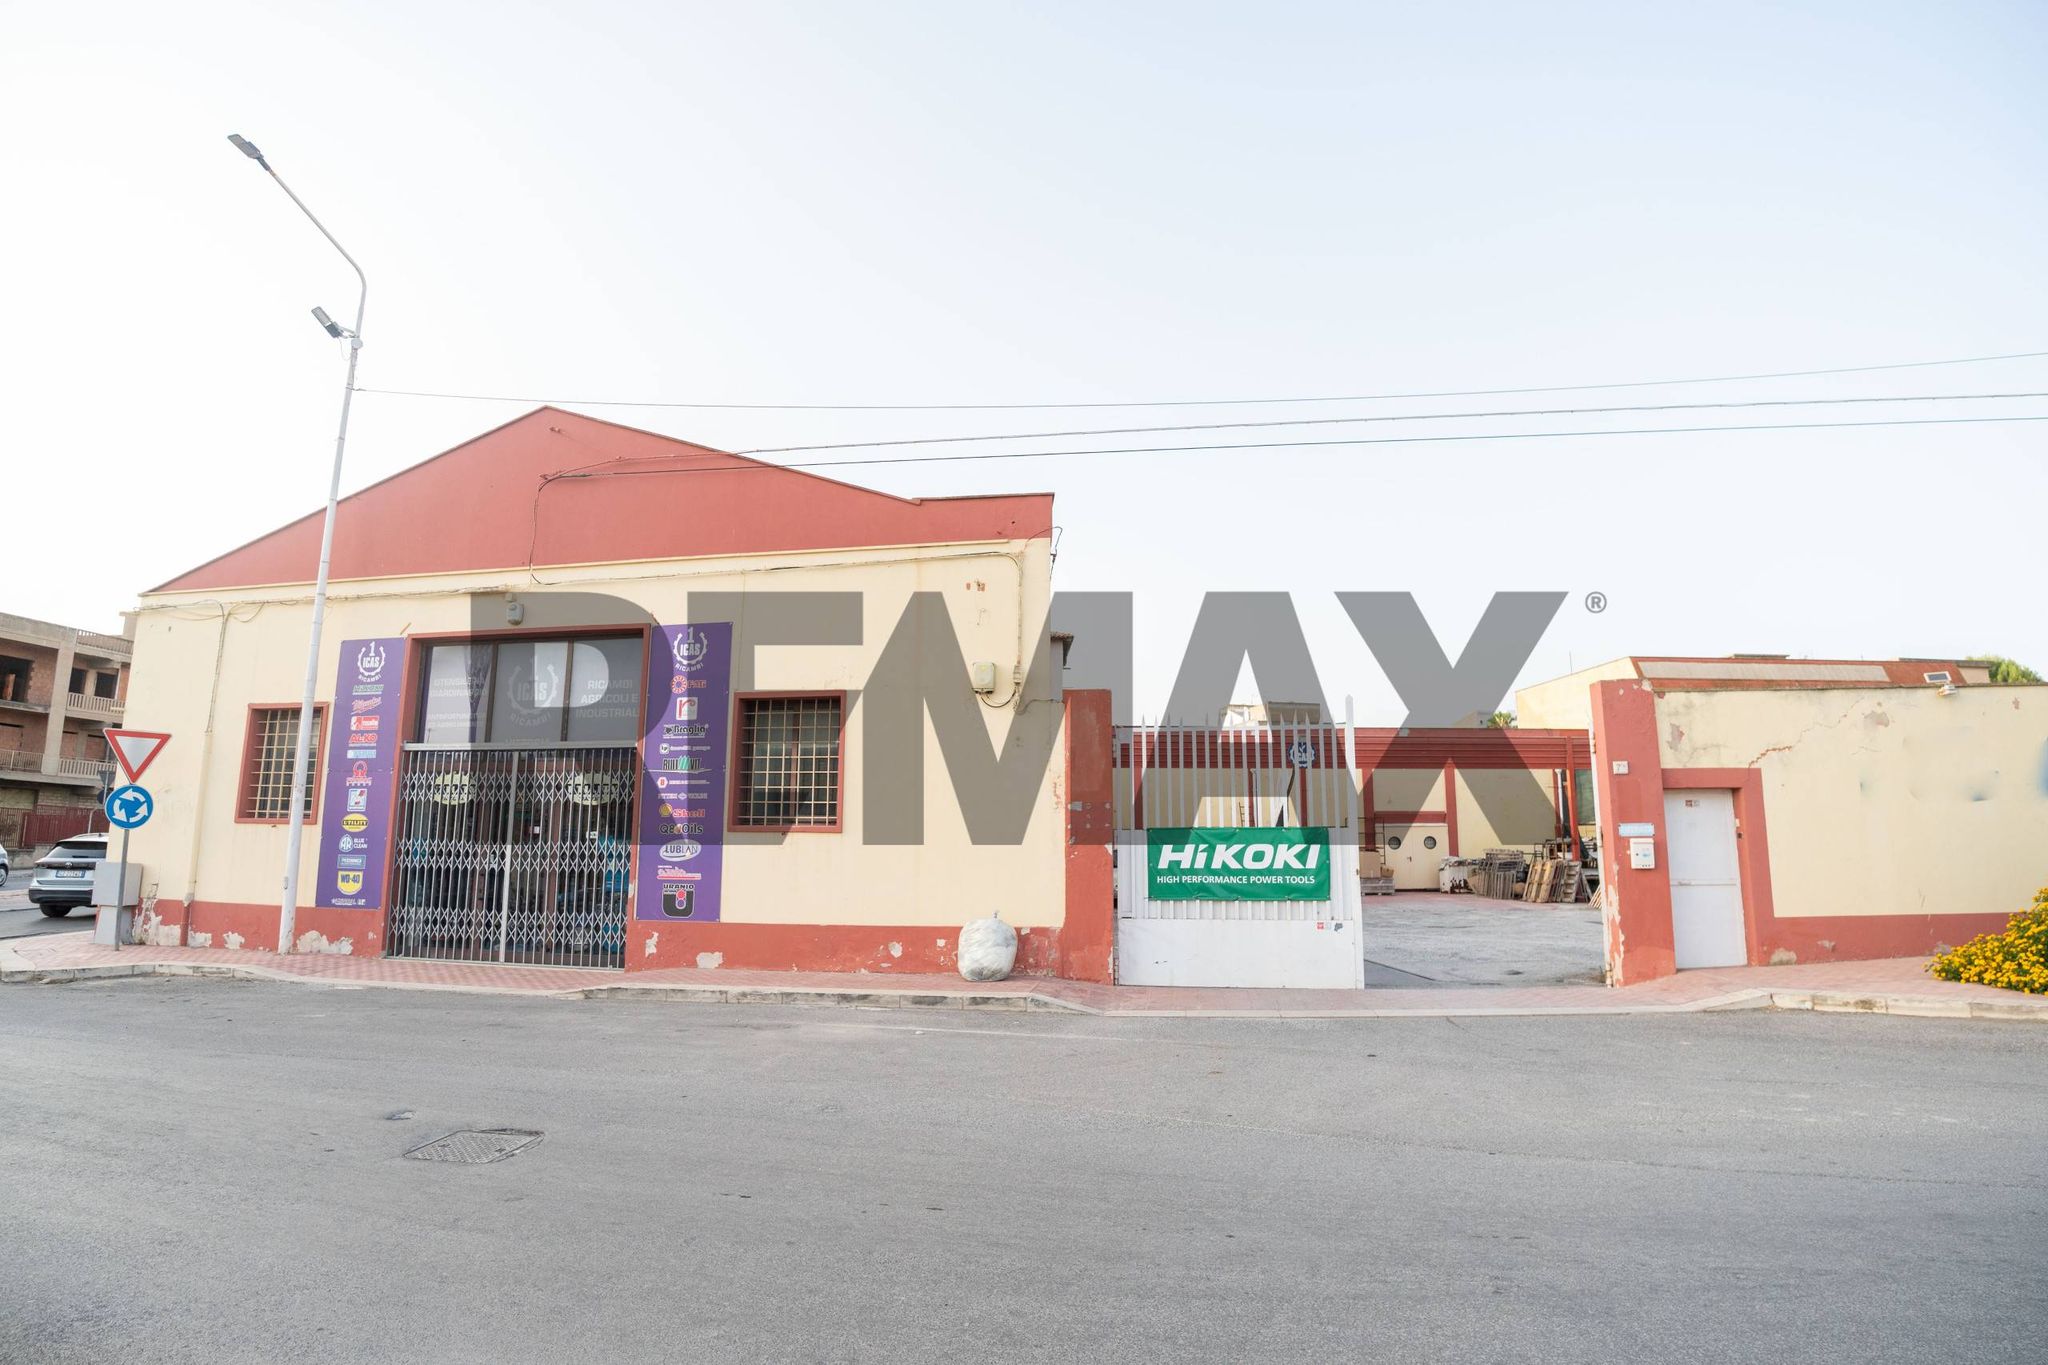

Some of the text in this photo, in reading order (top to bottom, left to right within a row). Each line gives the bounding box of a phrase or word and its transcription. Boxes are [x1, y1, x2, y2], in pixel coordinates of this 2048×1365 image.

[369, 641, 376, 656] 1
[680, 643, 700, 656] ICAS
[362, 656, 380, 668] ICAS
[674, 662, 704, 672] RICAMBI
[516, 680, 549, 701] ICAS
[587, 679, 634, 690] RICAMBI
[581, 692, 640, 704] AGRICOLI E
[575, 706, 640, 719] INDUSTRIAL
[509, 711, 552, 728] RICAMBI
[673, 809, 705, 817] Shell
[665, 845, 698, 854] LUBLAN
[1157, 843, 1321, 870] HiKOKI
[341, 874, 361, 884] WD-40
[1156, 875, 1316, 884] HIGH PERFORMANCE POWER TOOLS
